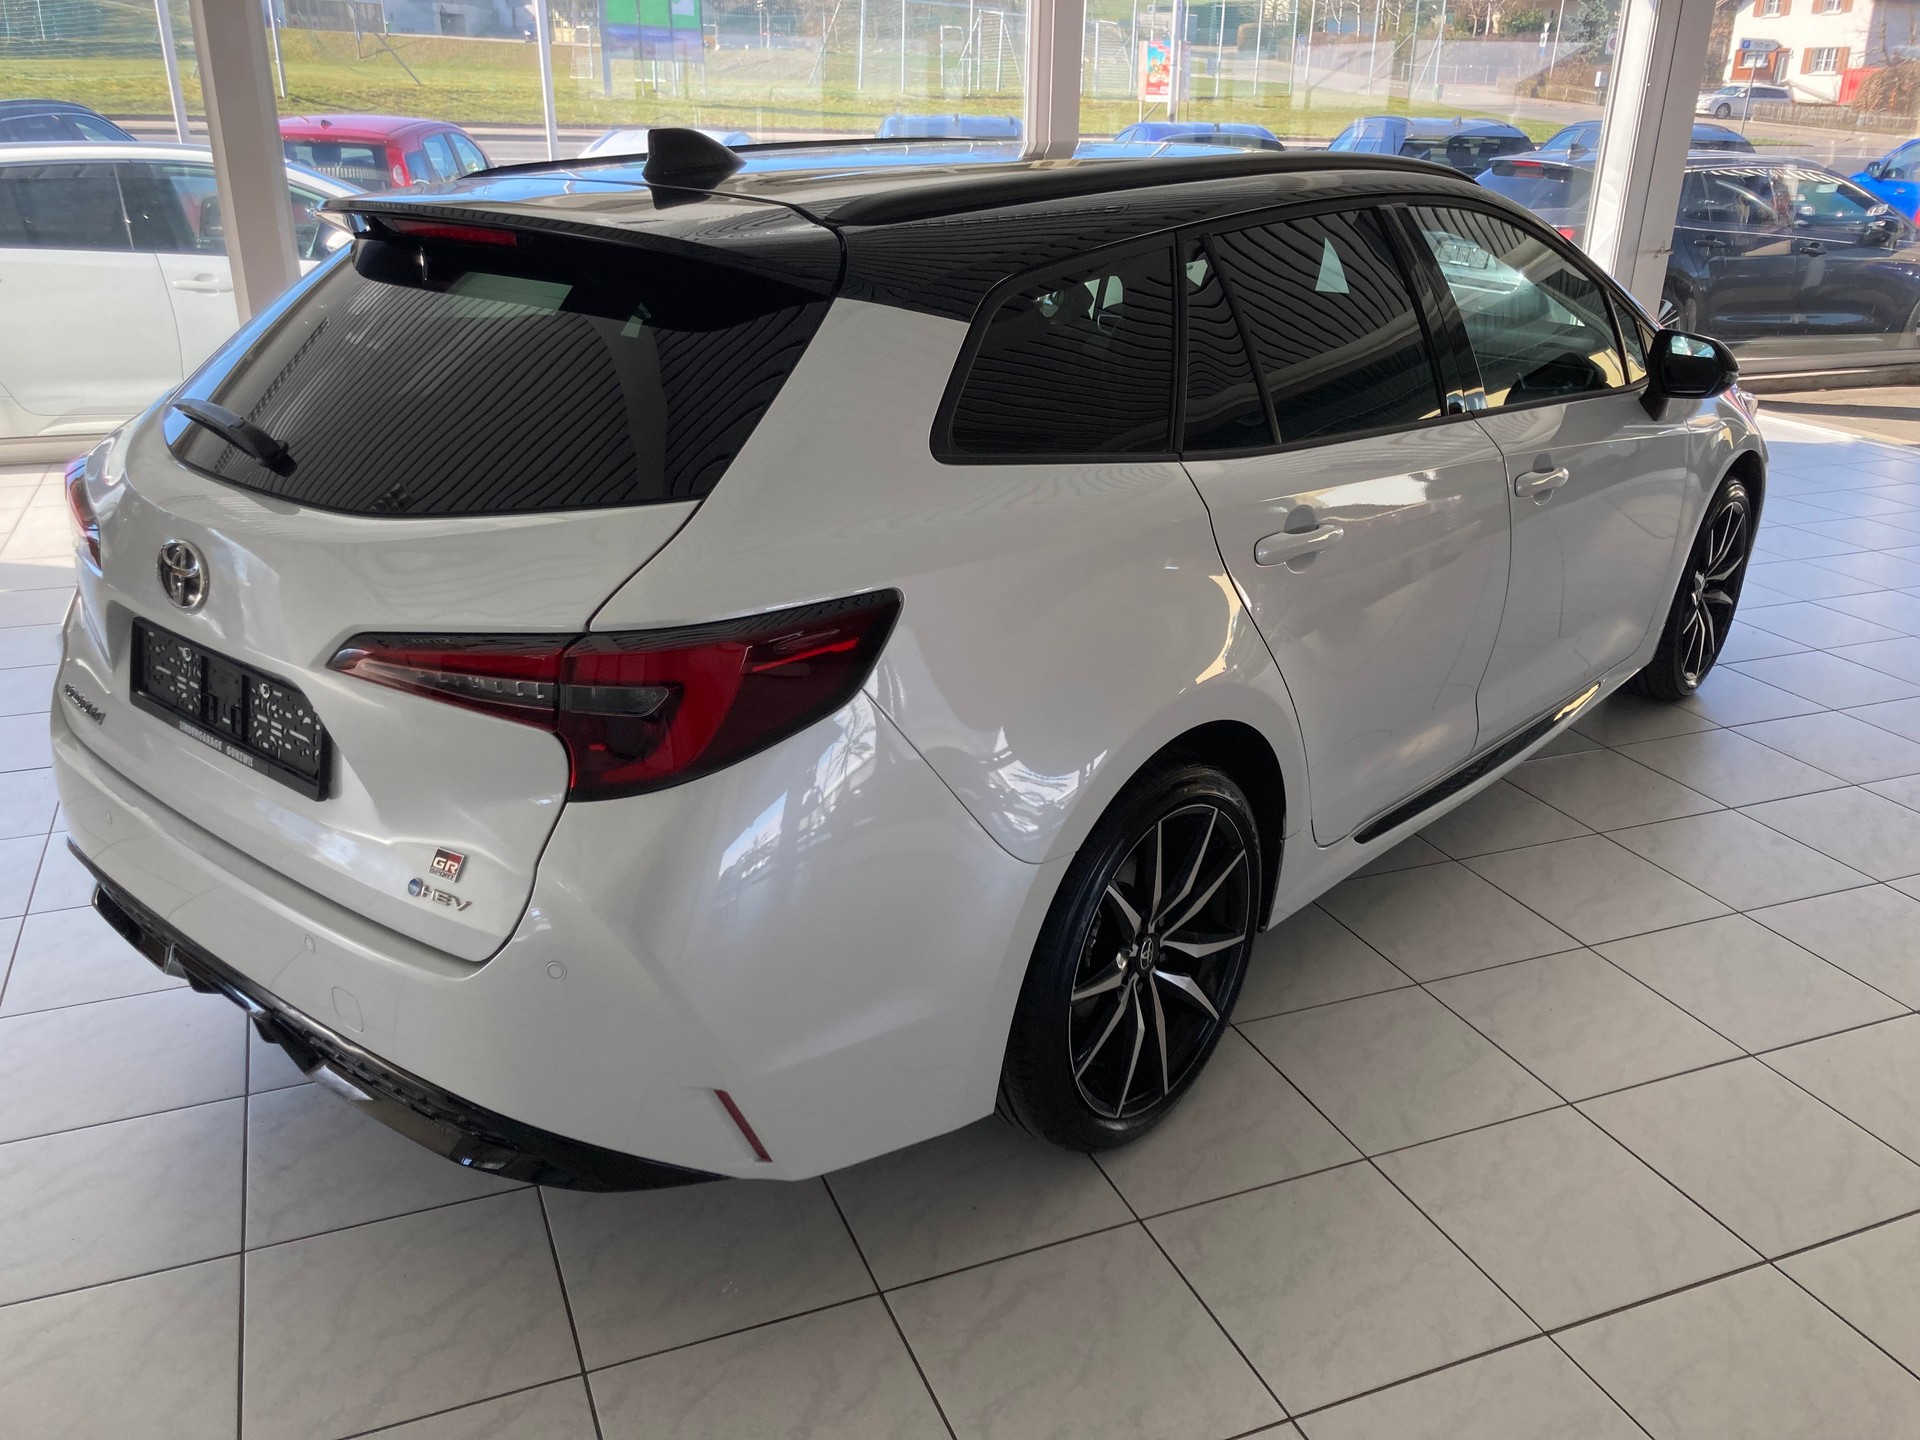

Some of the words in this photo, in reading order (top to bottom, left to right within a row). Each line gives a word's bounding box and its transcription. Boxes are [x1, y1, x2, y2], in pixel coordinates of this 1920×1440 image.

[431, 867, 456, 881] SPORT
[432, 856, 459, 874] GR
[421, 885, 472, 911] HEV
